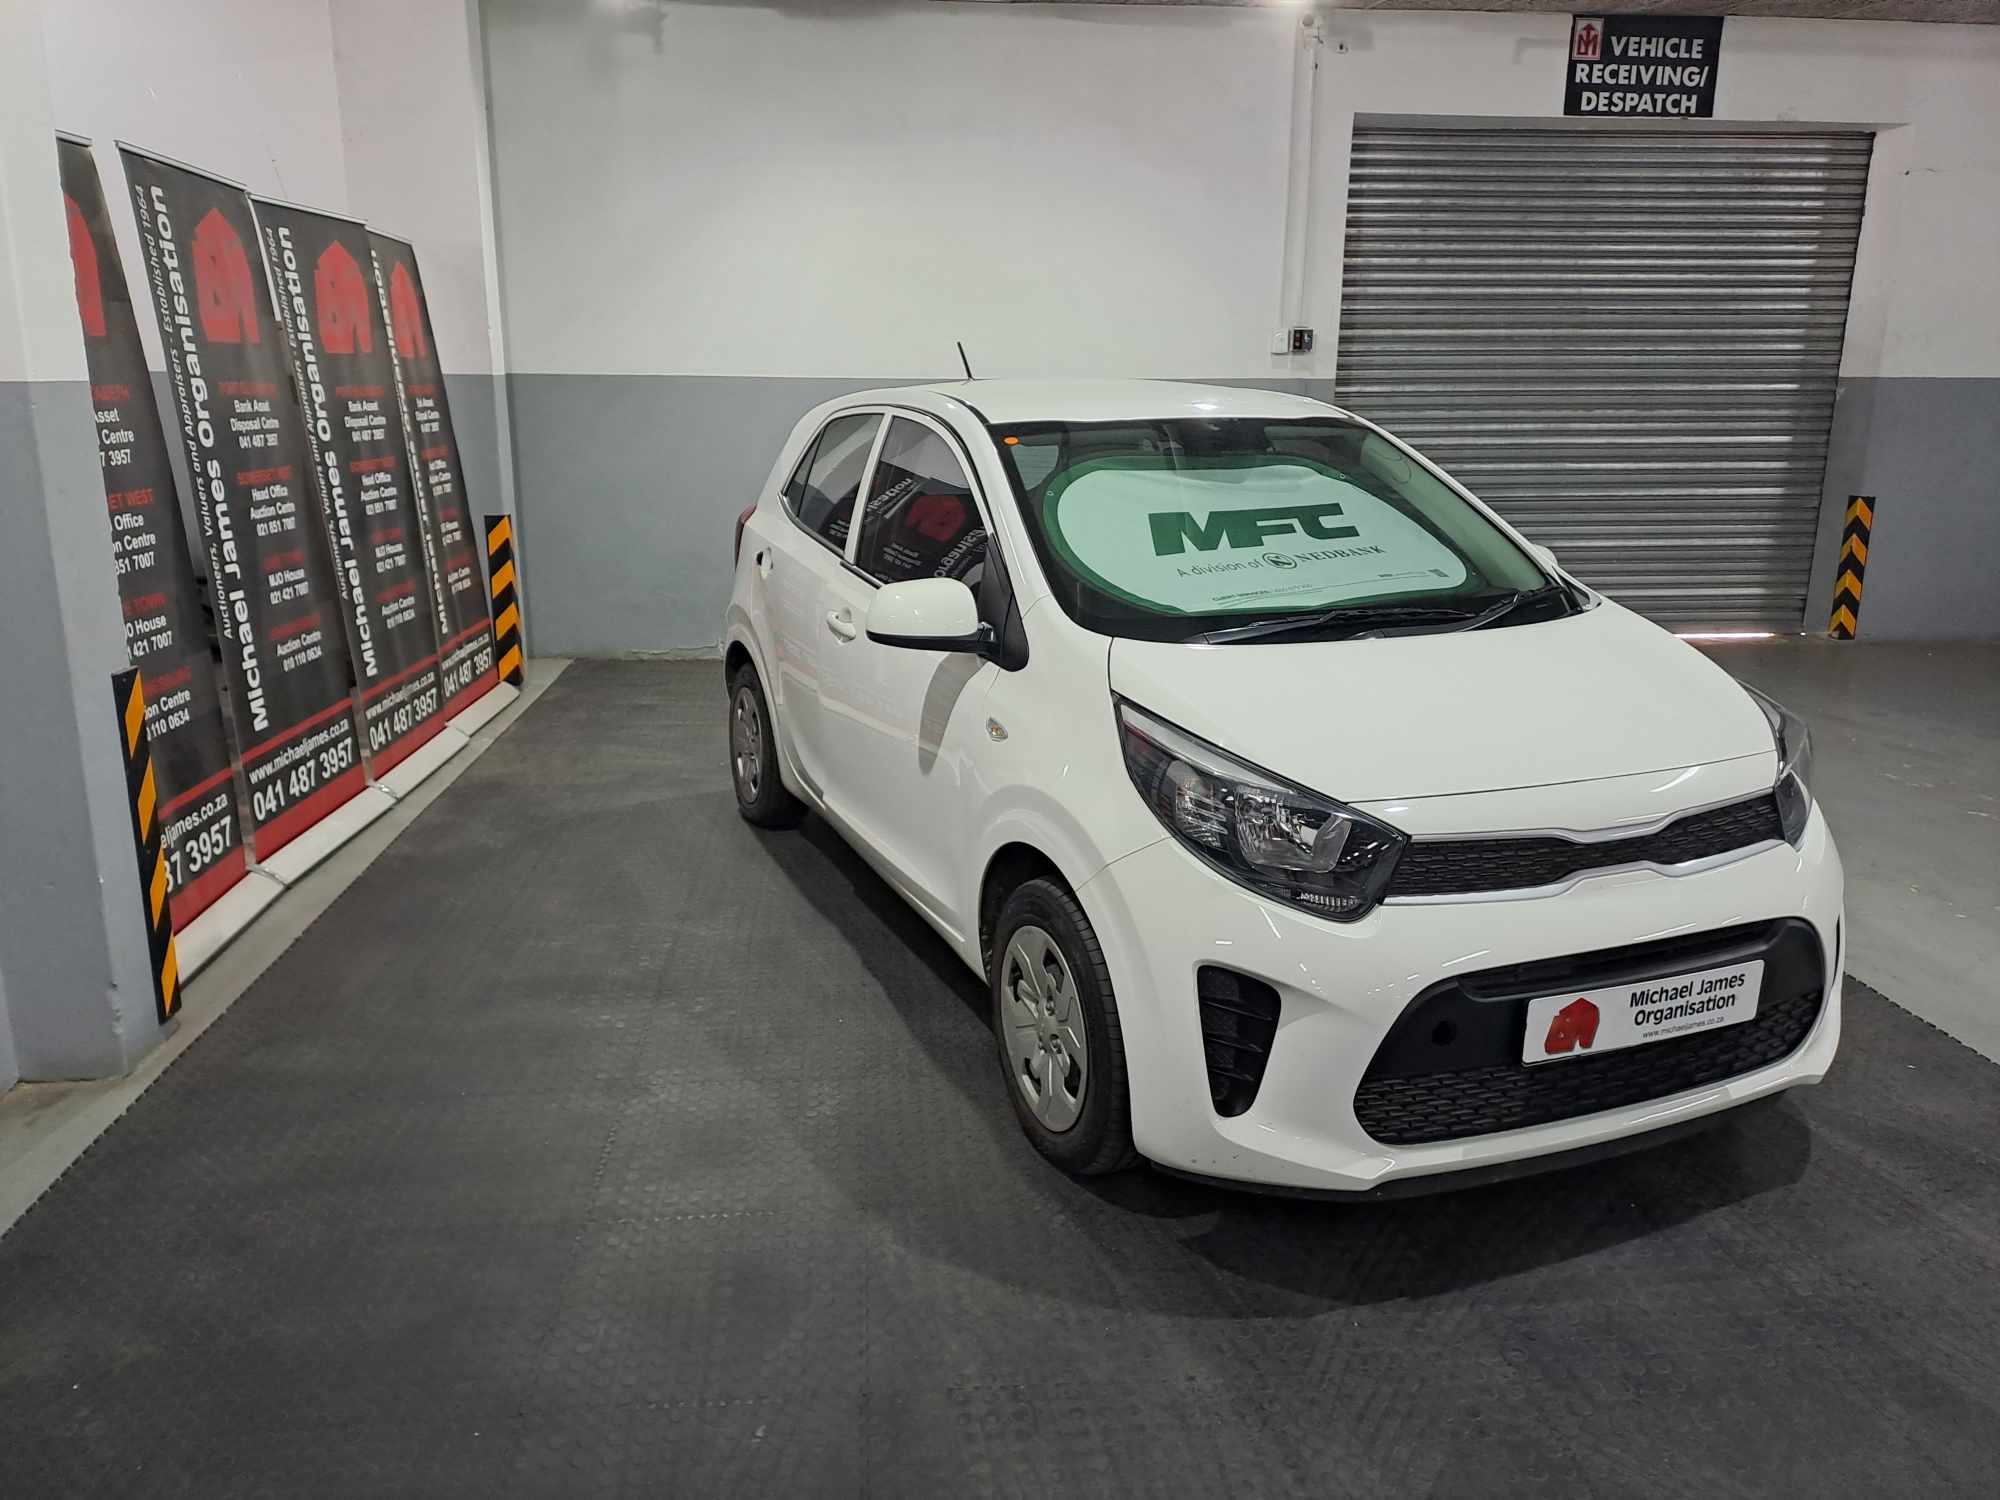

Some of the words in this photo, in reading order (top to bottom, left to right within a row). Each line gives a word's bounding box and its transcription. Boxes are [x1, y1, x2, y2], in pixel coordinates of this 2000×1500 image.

[1610, 35, 1704, 59] VEHICLE
[1575, 63, 1709, 88] RECEIVING/
[1580, 90, 1698, 115] DESPATCH
[134, 183, 151, 228] 1964
[150, 185, 215, 449] Organisation
[278, 226, 332, 442] Organisation
[102, 428, 135, 445] Centre
[108, 449, 131, 466] 3957
[187, 440, 202, 473] and
[323, 450, 354, 550] James
[113, 512, 145, 531] Office
[206, 459, 241, 580] James
[1148, 502, 1361, 557] MFC
[123, 532, 157, 551] Centre
[132, 551, 155, 570] 7007
[1177, 567, 1191, 578] A
[1191, 561, 1248, 576] division
[1247, 558, 1265, 569] of
[1293, 546, 1387, 561] NEDBANK
[134, 614, 167, 635] House
[344, 558, 378, 677] Michael
[133, 638, 150, 658] 421
[150, 630, 173, 651] 7007
[229, 589, 270, 732] Michael
[443, 670, 459, 697] 041
[459, 660, 472, 686] 487
[474, 646, 492, 675] 3957
[160, 689, 191, 712] Centre
[369, 717, 392, 751] 041
[393, 703, 413, 736] 487
[413, 686, 438, 722] 3957
[253, 778, 285, 821] 041
[289, 759, 316, 797] 487
[320, 736, 353, 779] 3957
[185, 814, 232, 873] 3957
[1629, 980, 1694, 1008] Michael
[1696, 973, 1746, 996] James
[1634, 993, 1736, 1026] Organisation
